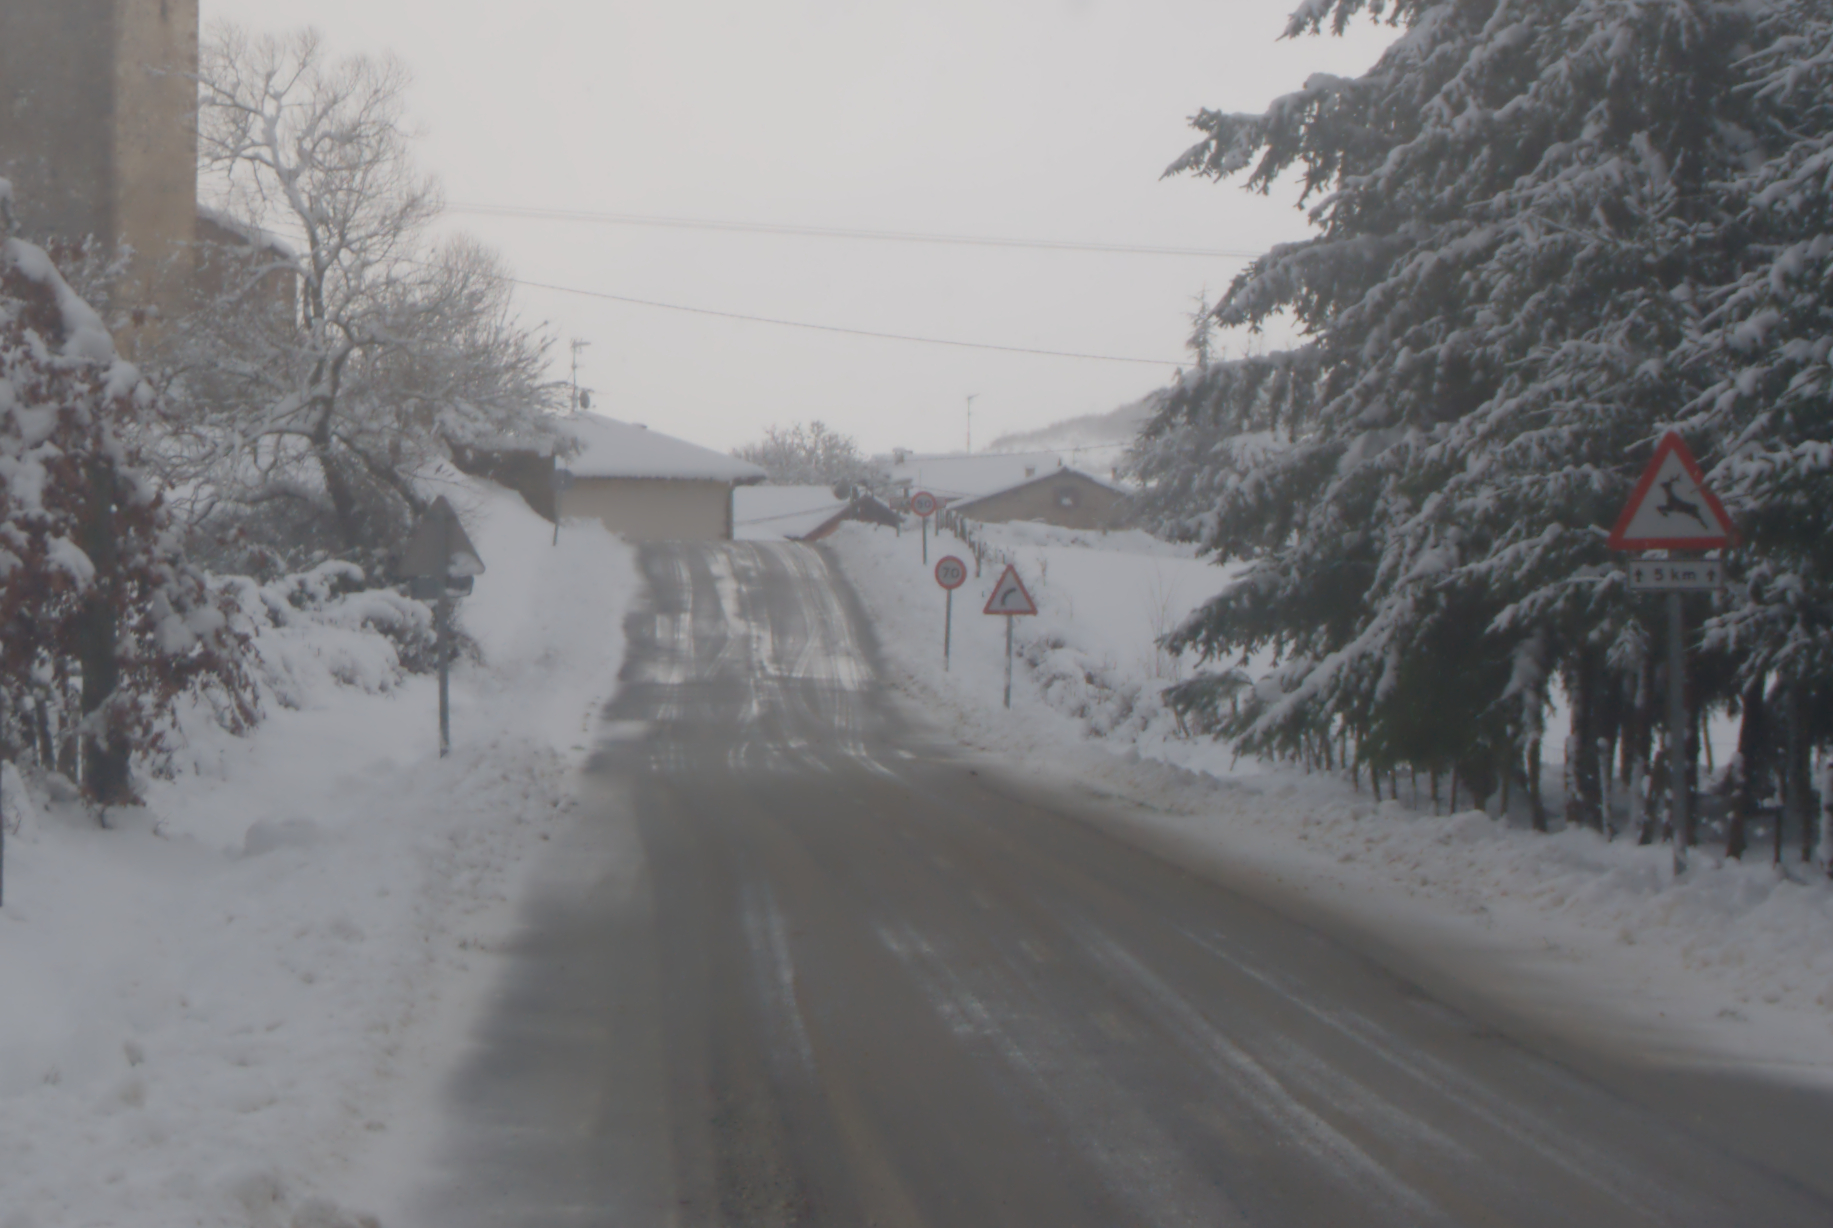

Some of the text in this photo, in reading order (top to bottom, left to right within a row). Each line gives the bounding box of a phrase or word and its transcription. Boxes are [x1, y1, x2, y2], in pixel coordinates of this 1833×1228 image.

[942, 567, 960, 578] 70
[1654, 568, 1696, 581] 5 km
